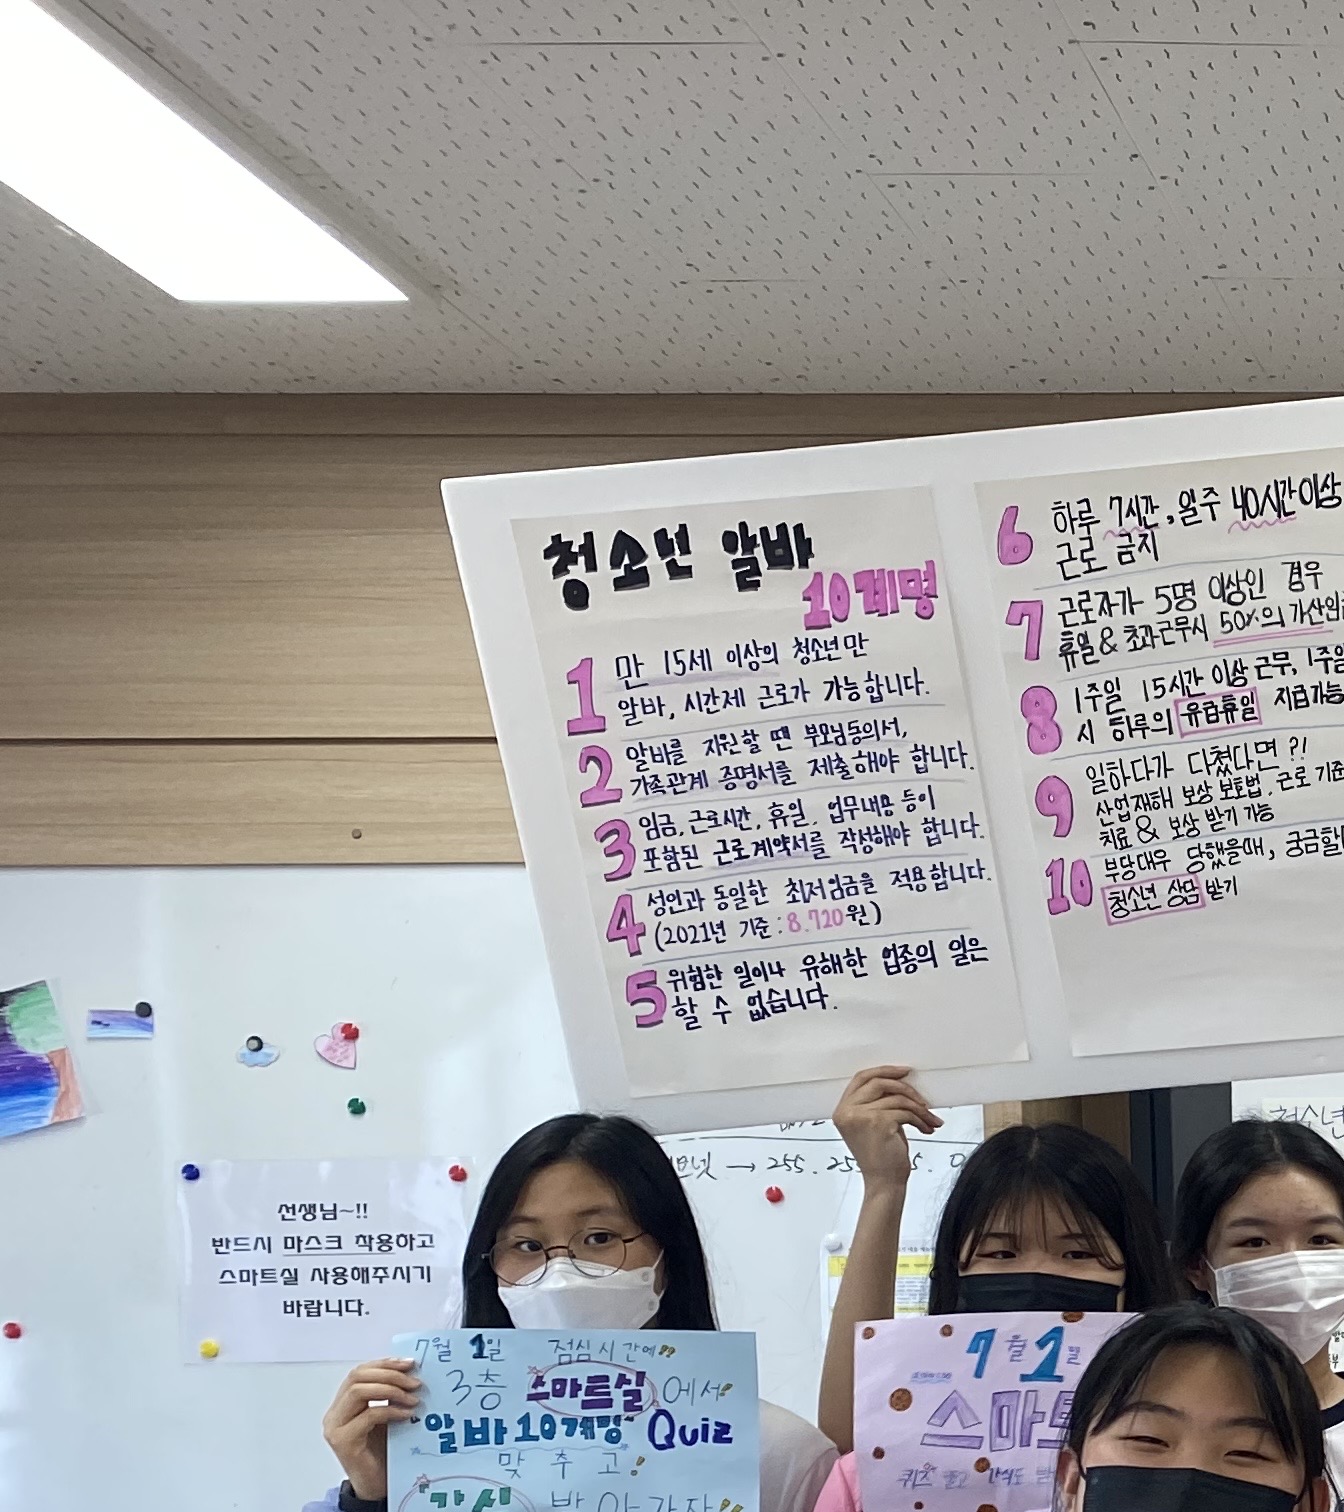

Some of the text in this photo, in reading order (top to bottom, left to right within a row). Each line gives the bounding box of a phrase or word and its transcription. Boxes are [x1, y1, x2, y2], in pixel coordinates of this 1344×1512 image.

[1052, 498, 1100, 535] 하루
[543, 520, 814, 611] 청소년 알바
[1056, 532, 1159, 581] 근로 금지
[802, 559, 938, 630] 10계명
[1057, 560, 1323, 628] 근로자가 5명 이상인 경우
[616, 640, 779, 689] 만 15세 이상의
[1074, 677, 1125, 716] 1주일
[1143, 668, 1204, 702] 15시간
[1212, 658, 1248, 688] 이상
[1254, 652, 1298, 680] 근무,
[618, 679, 811, 726] 알바, 시간제 근로가
[1077, 692, 1259, 744] 시 하루의 유급휴일
[626, 729, 760, 772] 알바를 지원할
[632, 740, 974, 797] 가족관계 증명서를 제출해야 합니다.
[1086, 752, 1174, 795] 일하다가
[901, 785, 936, 812] 등이
[1096, 792, 1174, 828] 산업재해
[1182, 781, 1212, 807] 보상
[643, 812, 985, 873] 포함된 작성해야 합니다.
[1100, 801, 1274, 849] 치료 보상 받기 가능
[1105, 849, 1172, 883] 부당대우
[647, 887, 705, 917] 성인과
[713, 879, 768, 909] 동일한
[1108, 875, 1239, 919] 청소년 상담 받기
[655, 919, 727, 952] (2021년
[667, 935, 988, 992] 위험한 일이나 유해한 업종의 일은
[673, 983, 838, 1031] 할 수 없습니다.
[212, 1233, 435, 1254] 반드시 마스크 착용하고
[219, 1266, 431, 1284] 스마트실 사용해주시기
[283, 1299, 370, 1317] 바랍니다.
[415, 1337, 451, 1368] 7월
[446, 1369, 507, 1410] 3층
[648, 1409, 733, 1451] Quiz
